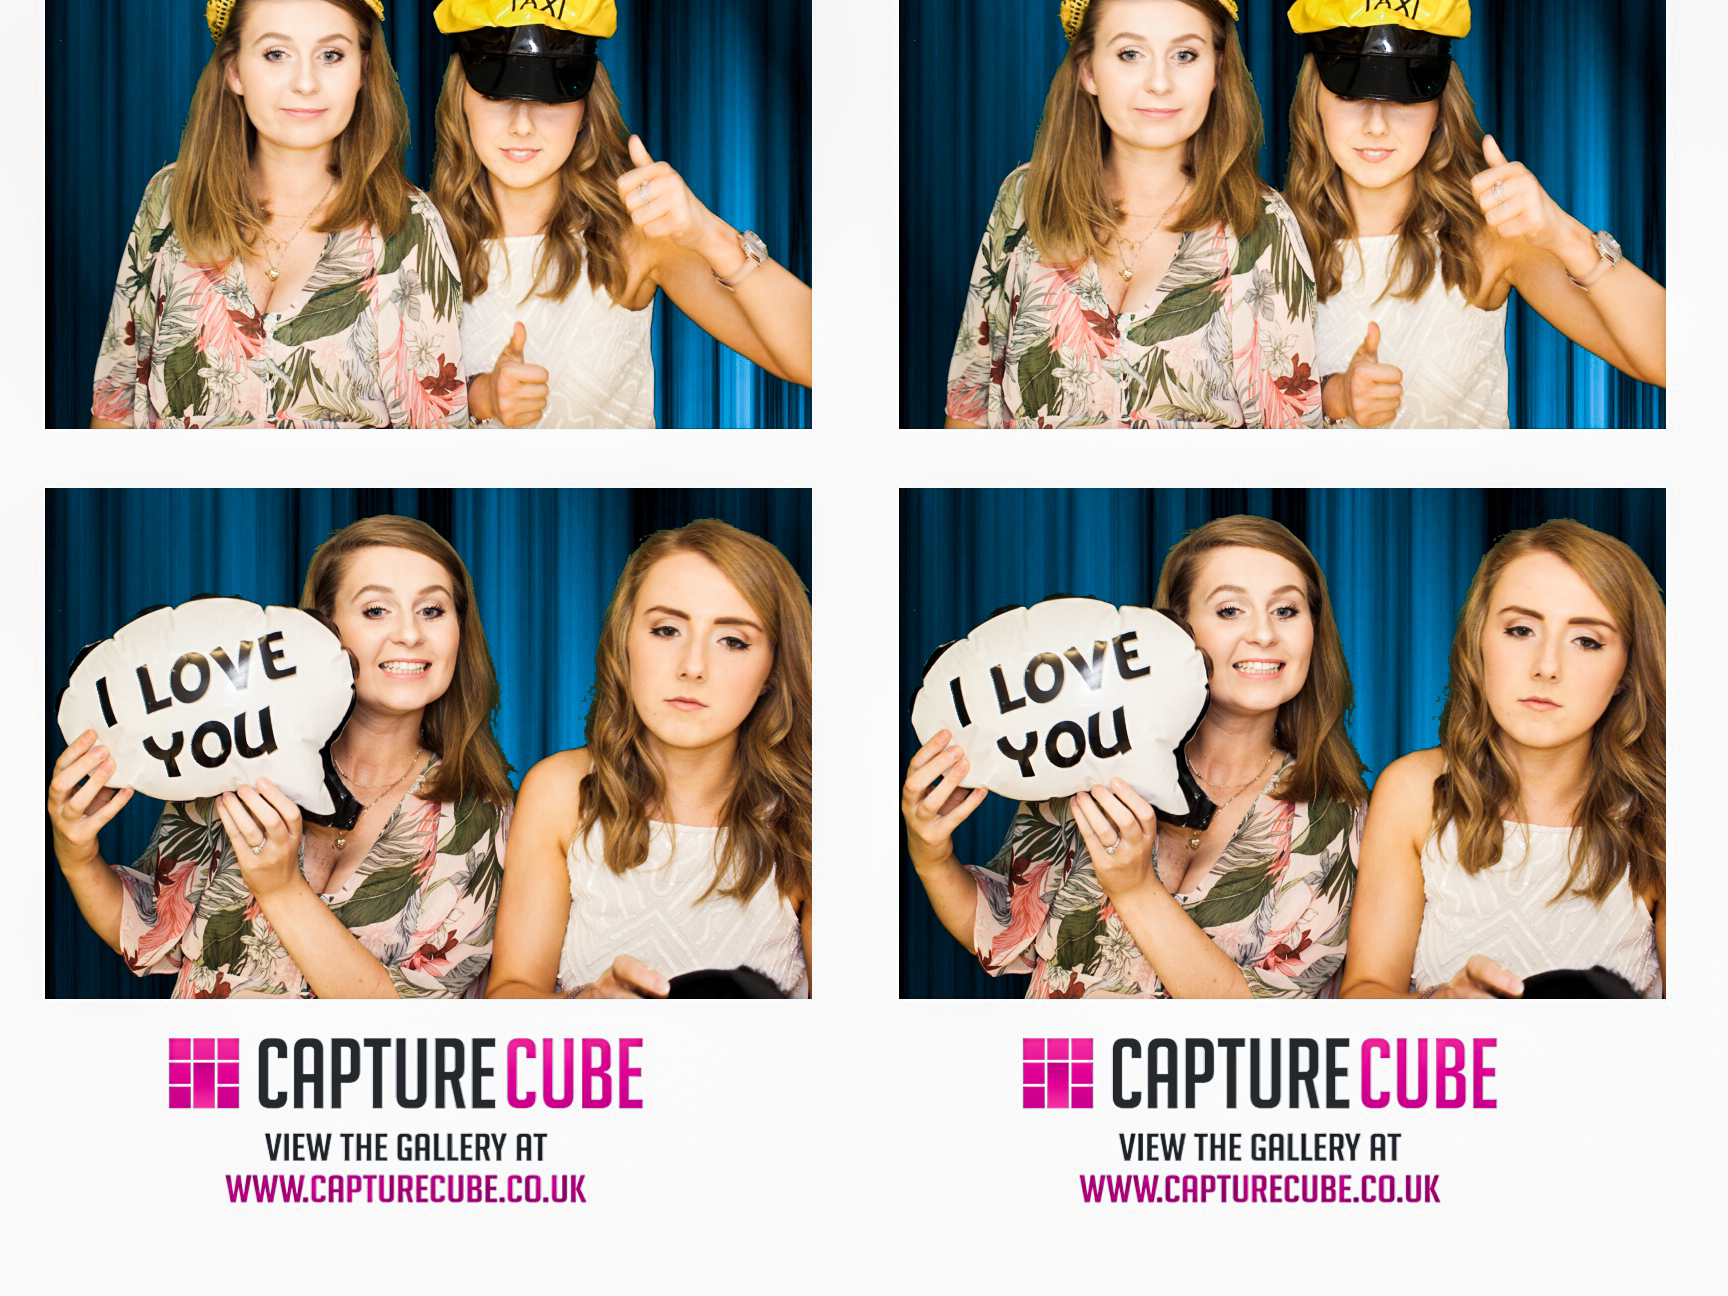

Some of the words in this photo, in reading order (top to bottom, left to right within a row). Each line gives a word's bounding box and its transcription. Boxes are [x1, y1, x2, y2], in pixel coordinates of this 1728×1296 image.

[95, 676, 118, 728] I
[135, 630, 297, 715] LOVE
[949, 676, 972, 728] I
[989, 630, 1151, 715] LOVE
[142, 705, 279, 778] YOU
[996, 705, 1133, 778] YOU
